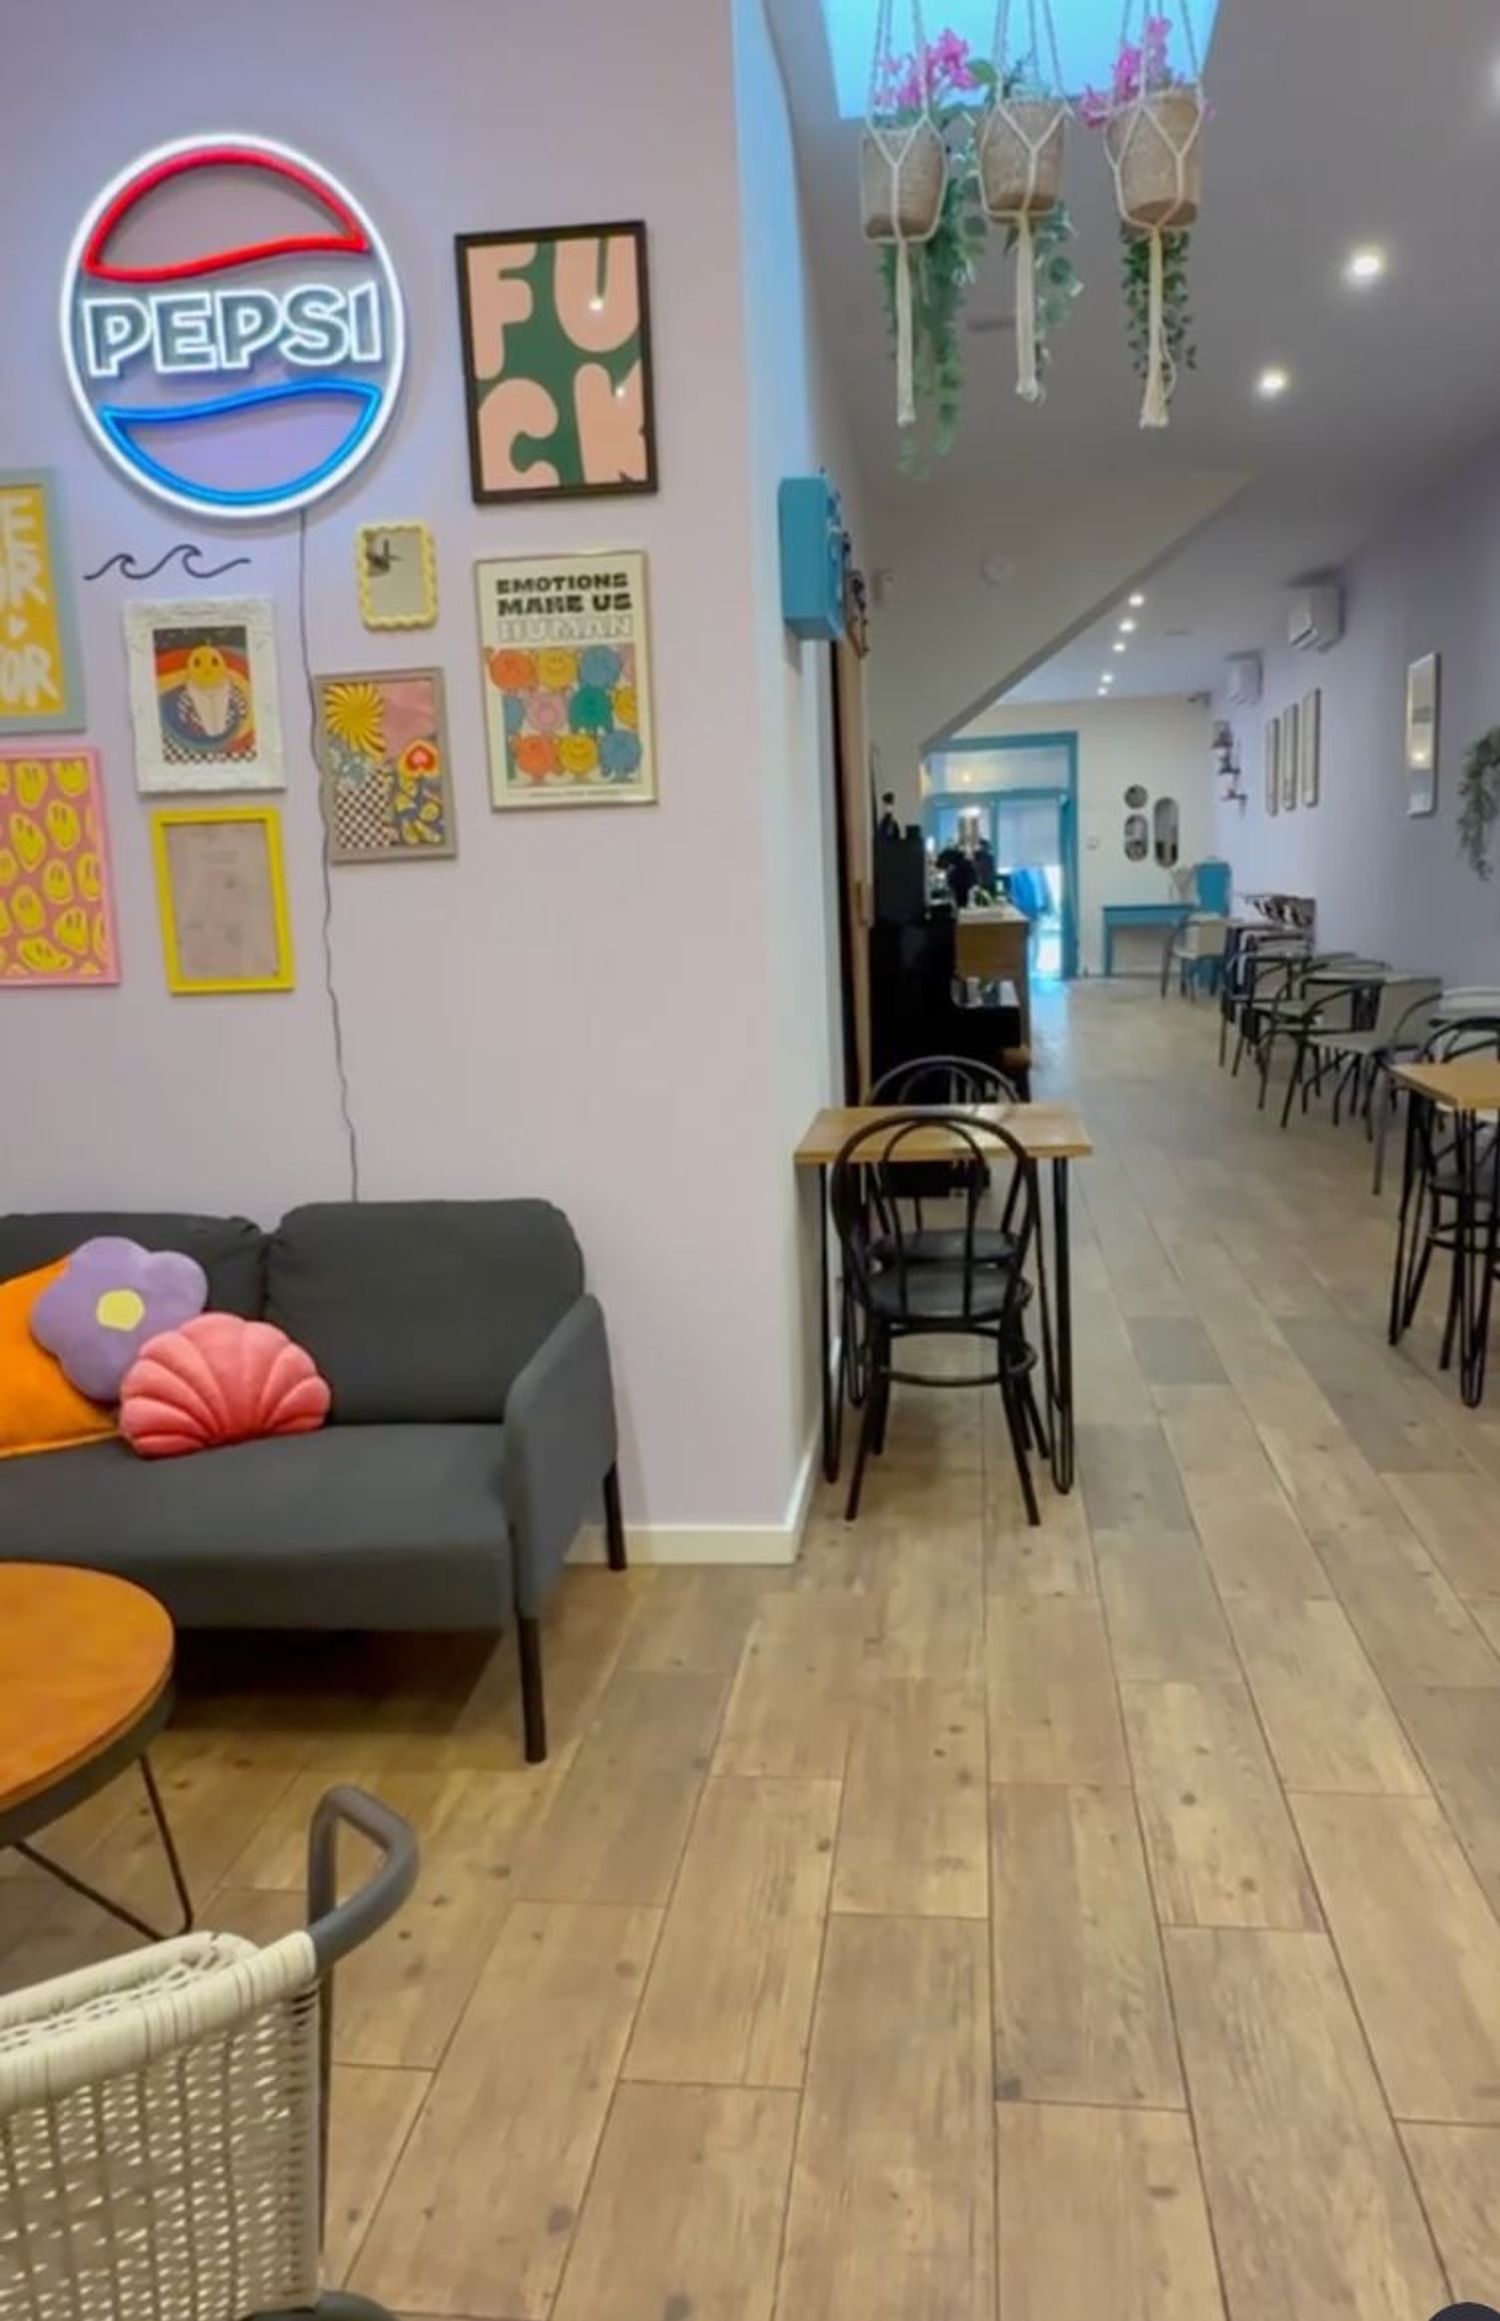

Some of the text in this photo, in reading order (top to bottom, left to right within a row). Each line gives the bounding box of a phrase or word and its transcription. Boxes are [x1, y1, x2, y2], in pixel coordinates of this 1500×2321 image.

[83, 280, 384, 378] PEPSI
[496, 572, 629, 595] EMOTIONS
[497, 592, 633, 617] MAKE US
[497, 615, 634, 643] HUMAN
